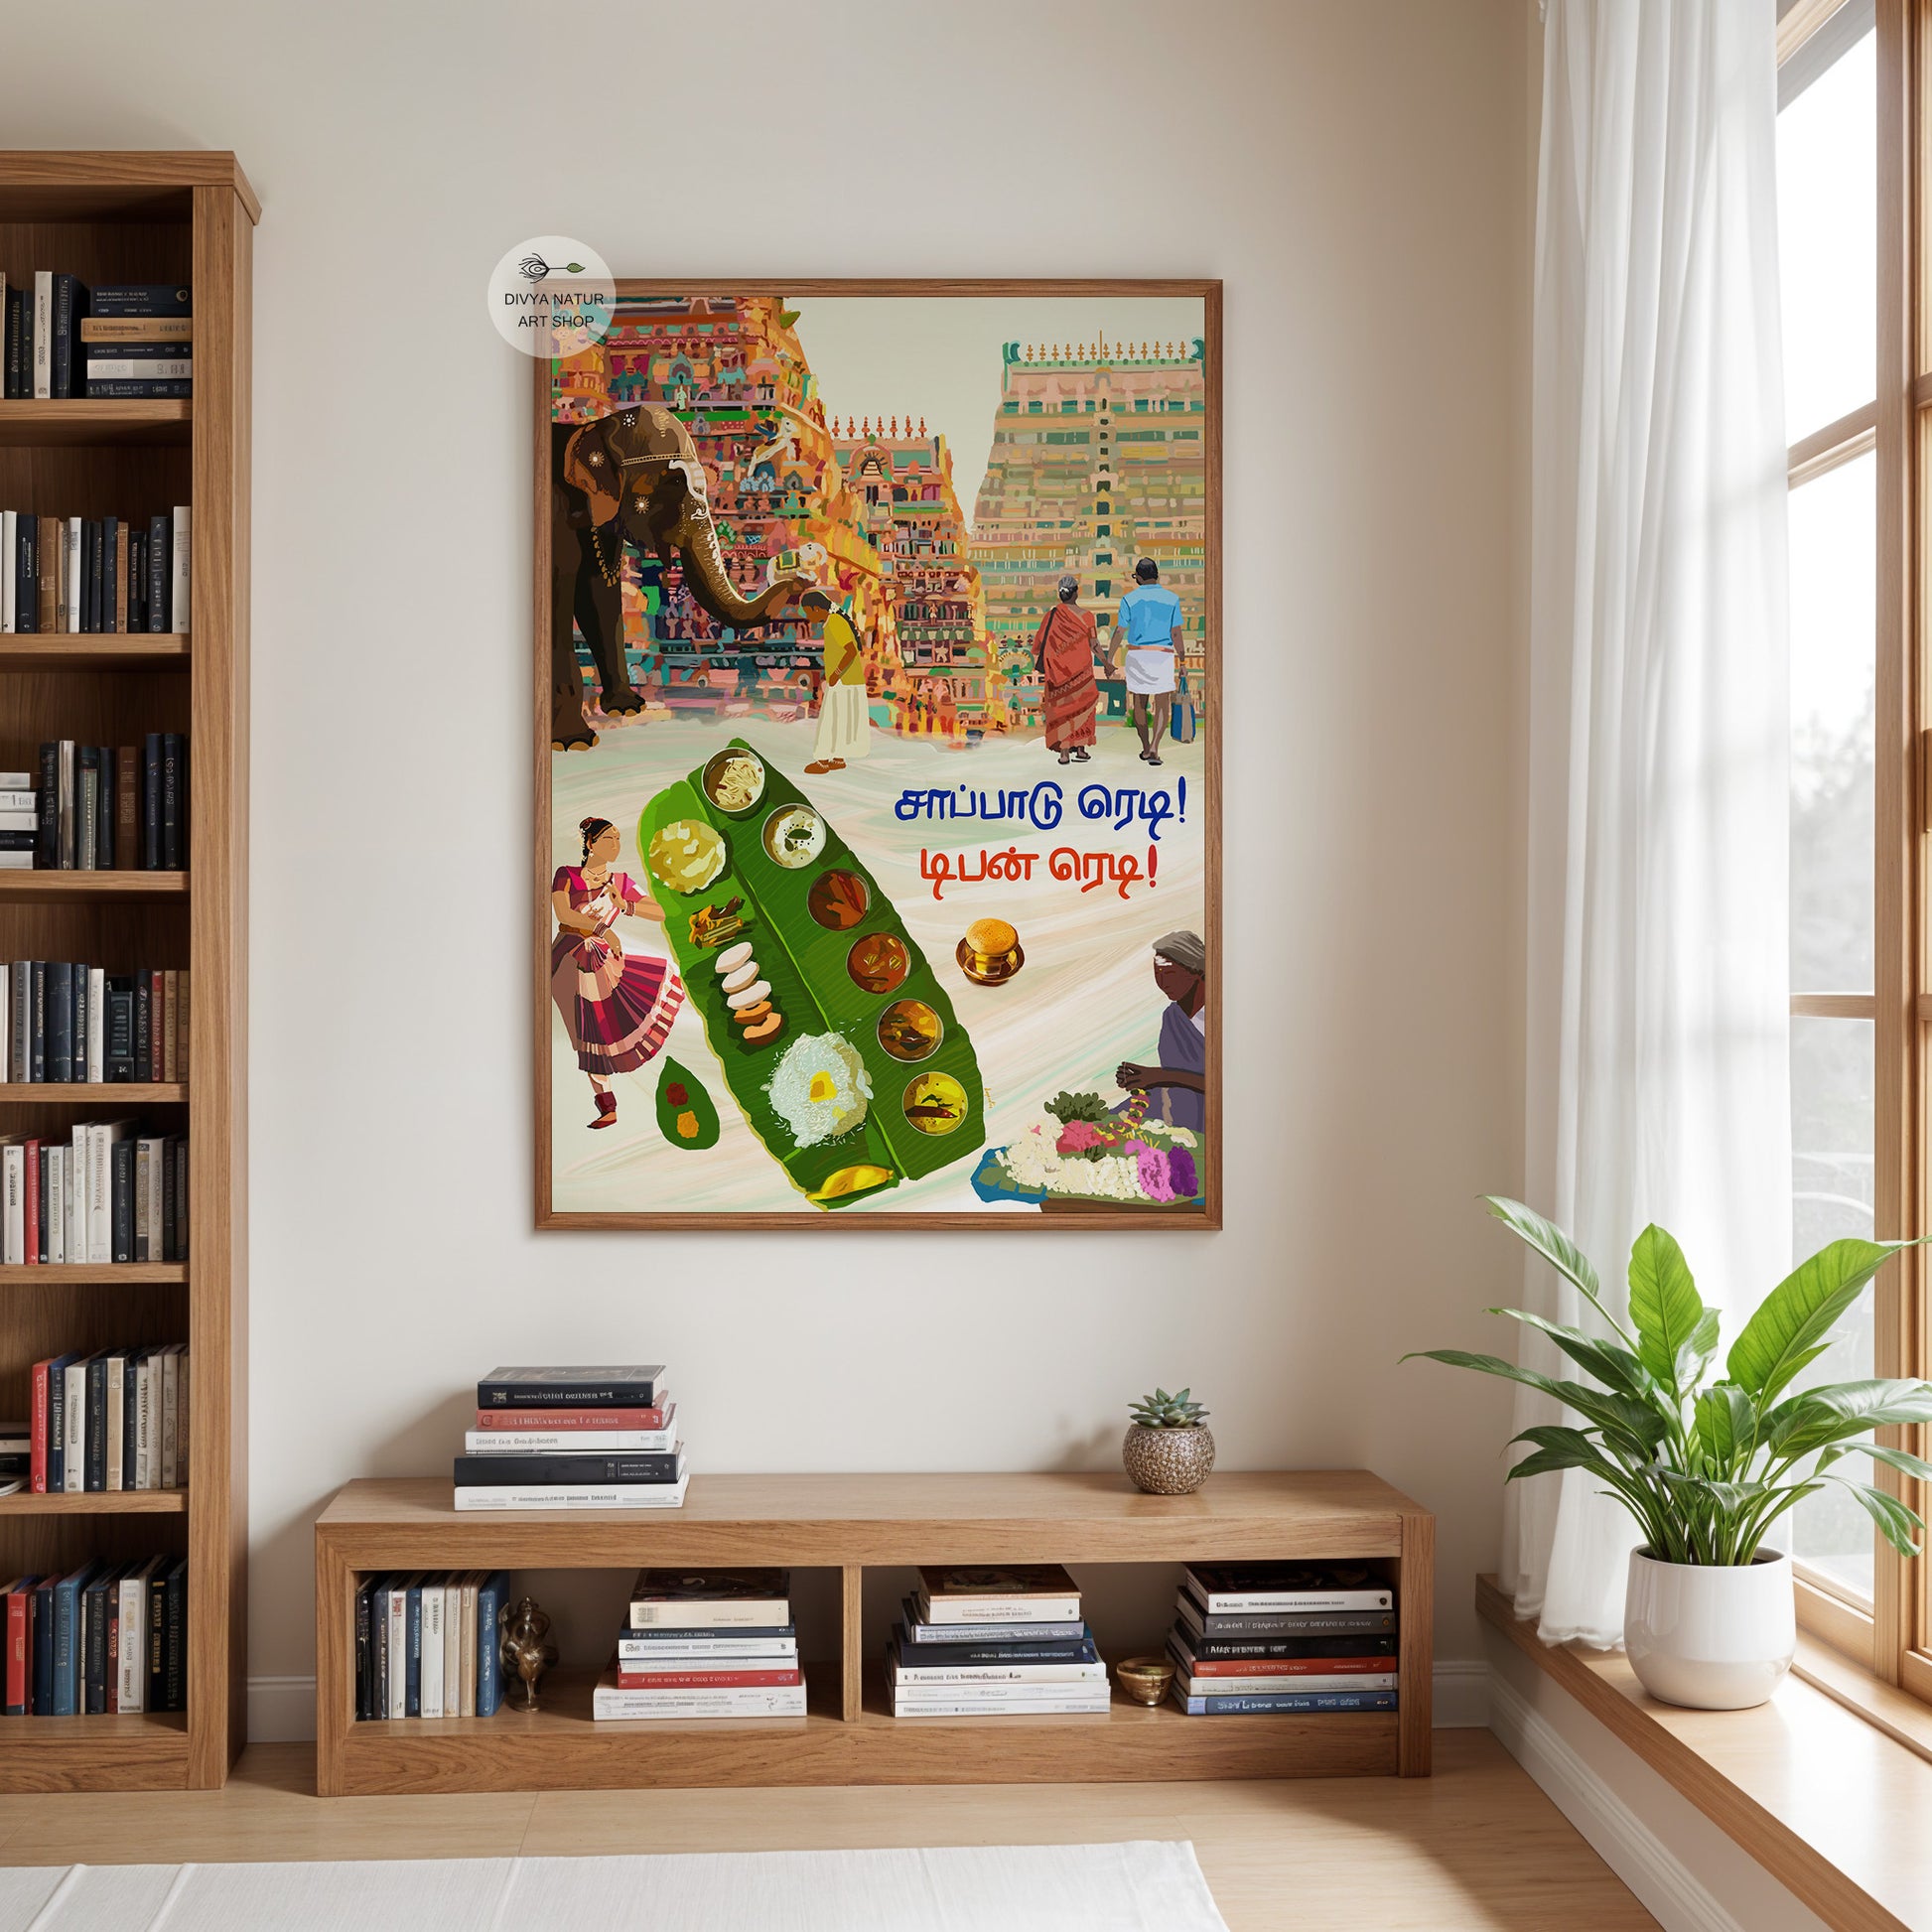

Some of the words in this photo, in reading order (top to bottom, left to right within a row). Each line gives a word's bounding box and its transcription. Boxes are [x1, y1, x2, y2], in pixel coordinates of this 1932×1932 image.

[894, 781, 1063, 830] சாப்பாடு
[1077, 775, 1187, 841] ரெடி!
[920, 846, 1039, 900] டிபன்
[1048, 844, 1159, 899] ரெடி!
